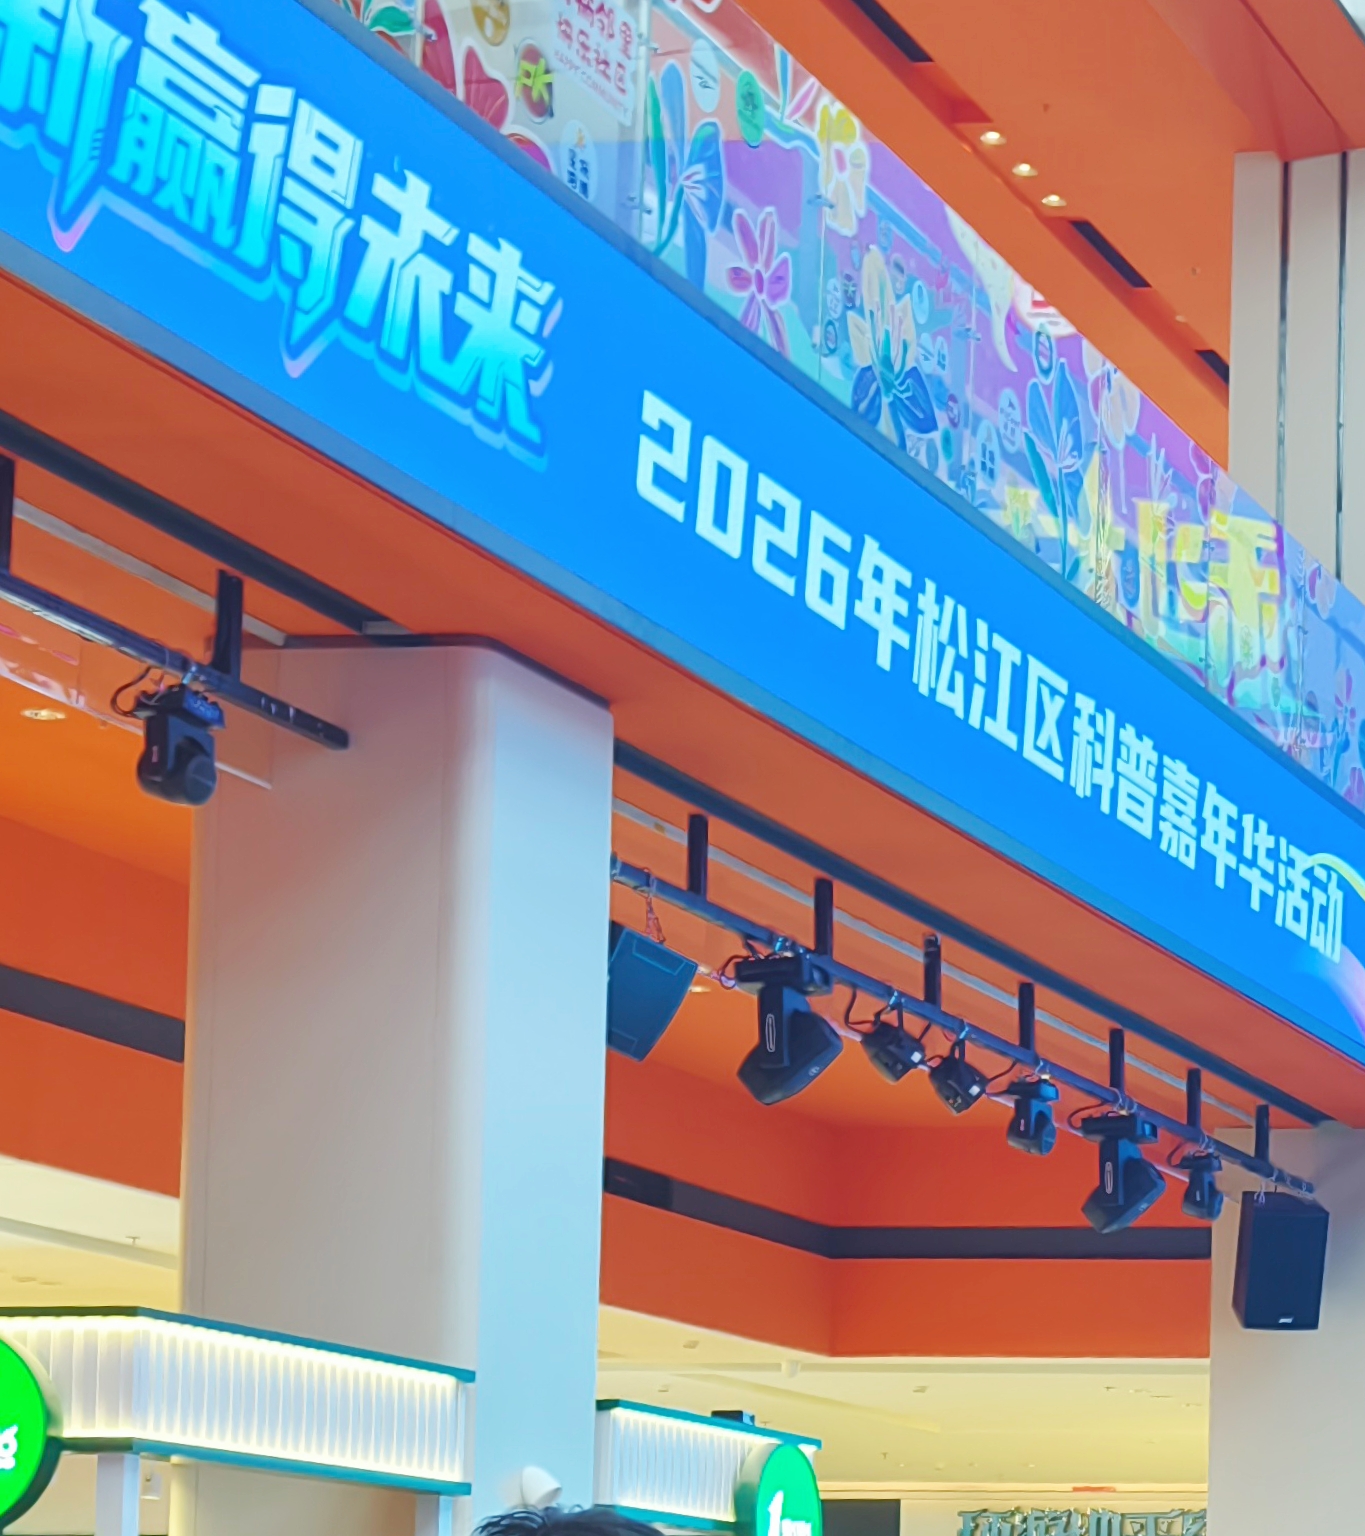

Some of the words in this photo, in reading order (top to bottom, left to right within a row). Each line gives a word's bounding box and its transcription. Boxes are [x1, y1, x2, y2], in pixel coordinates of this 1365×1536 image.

[636, 389, 1343, 964] 2026年松江区科普嘉年华活动
